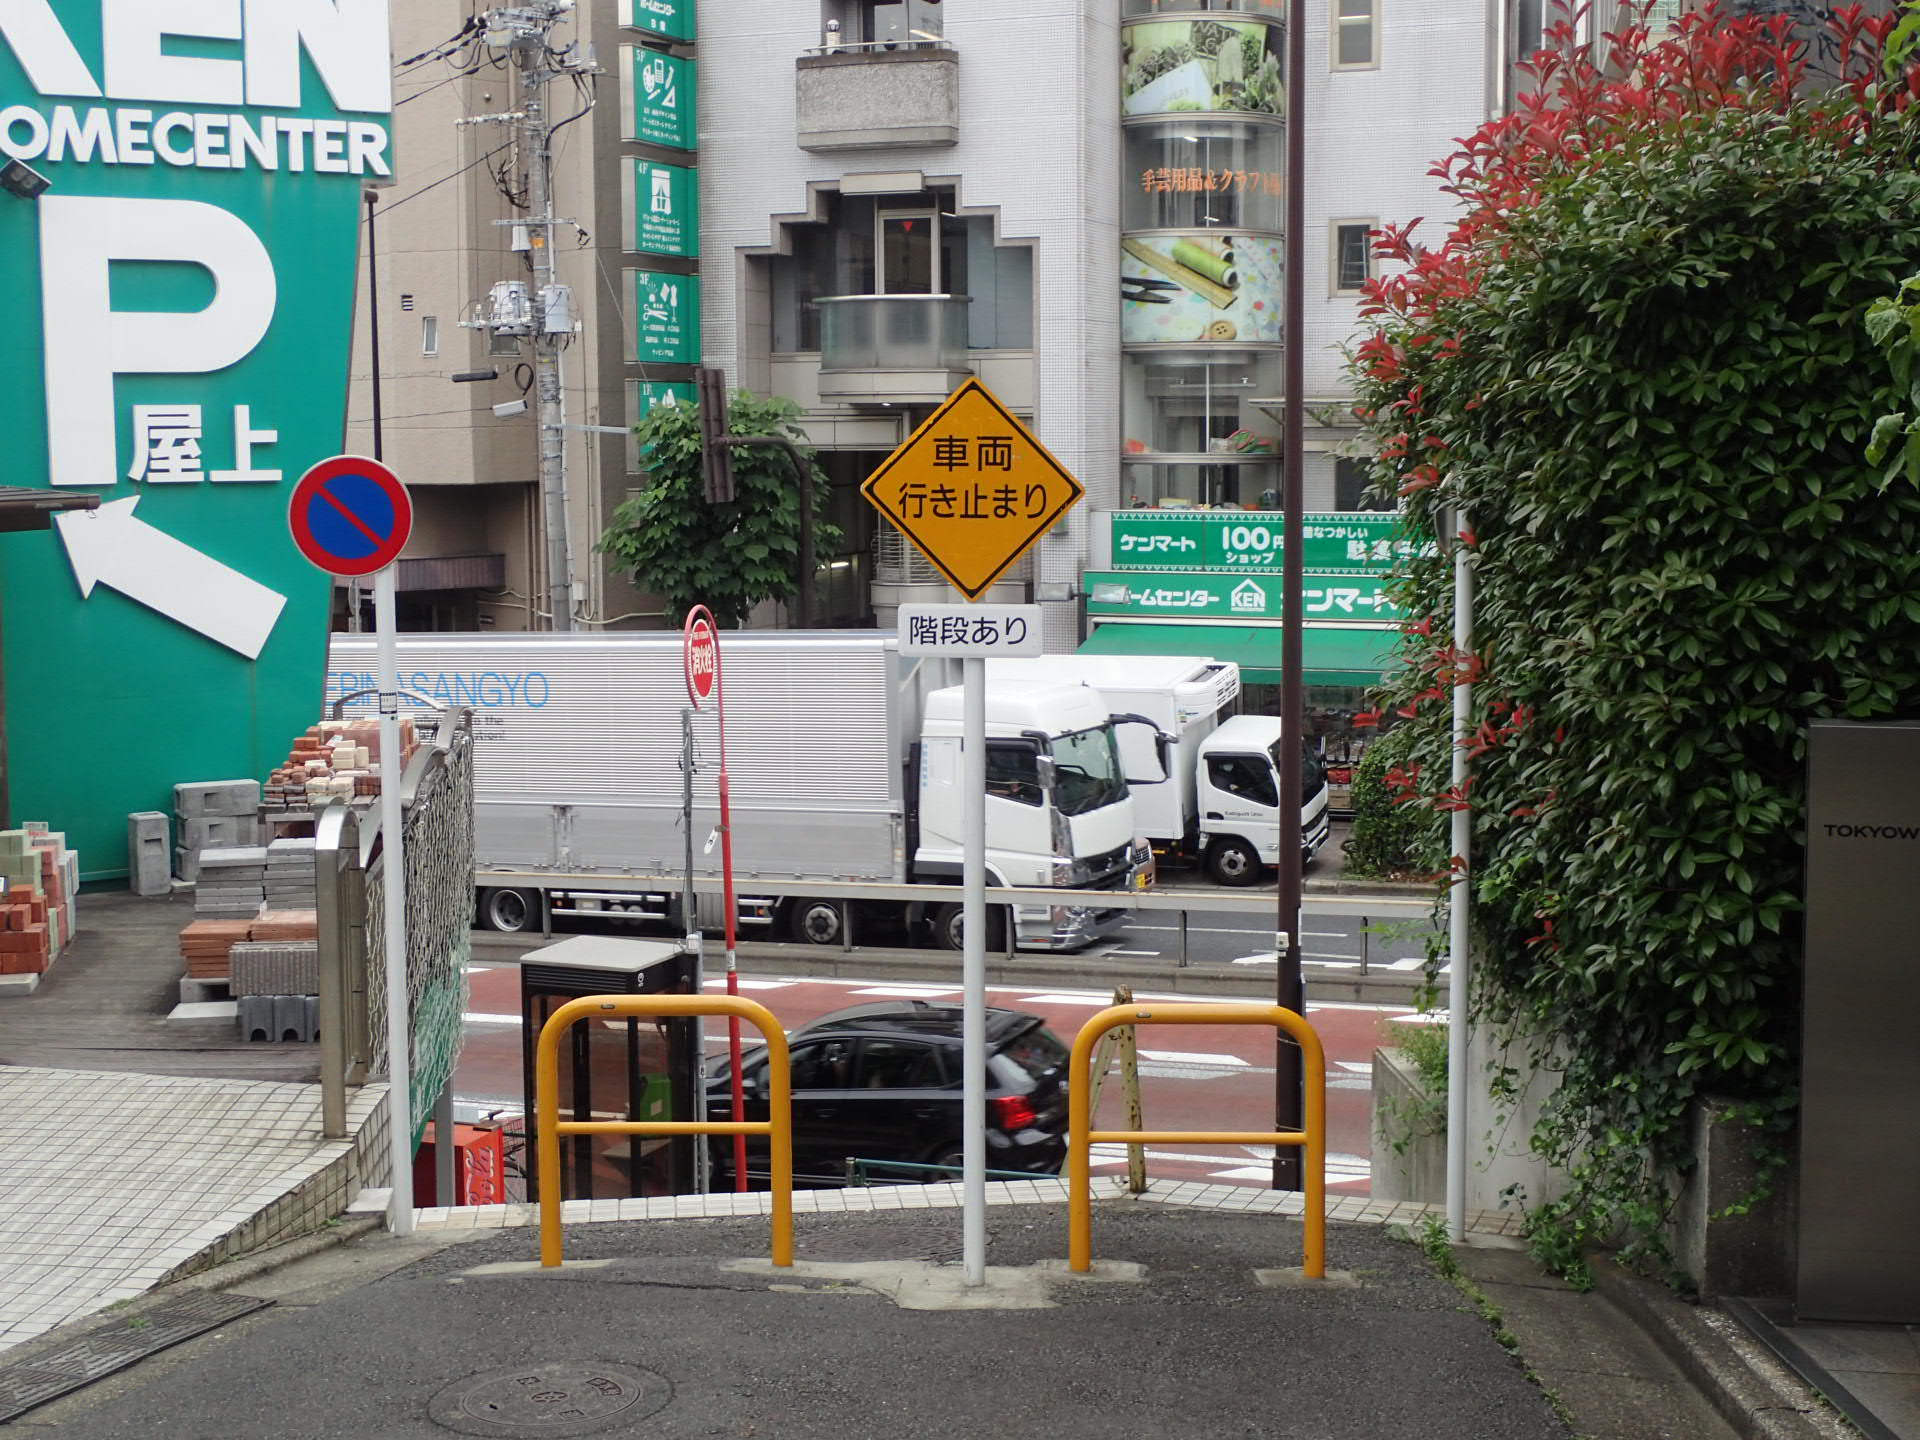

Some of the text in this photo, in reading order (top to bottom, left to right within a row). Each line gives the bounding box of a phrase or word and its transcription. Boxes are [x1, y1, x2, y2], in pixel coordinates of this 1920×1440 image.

[0, 0, 391, 113] EN
[38, 195, 277, 486] P
[128, 405, 282, 484] 屋上
[932, 434, 1013, 471] 車両
[898, 482, 1048, 519] 行き止まり
[1120, 534, 1196, 552] ケンマート
[1226, 551, 1275, 564] ショップ
[1127, 588, 1220, 607] ームセンター
[1231, 592, 1266, 608] KEN
[909, 615, 1028, 646] 階段あり
[692, 643, 713, 675] 消火栓
